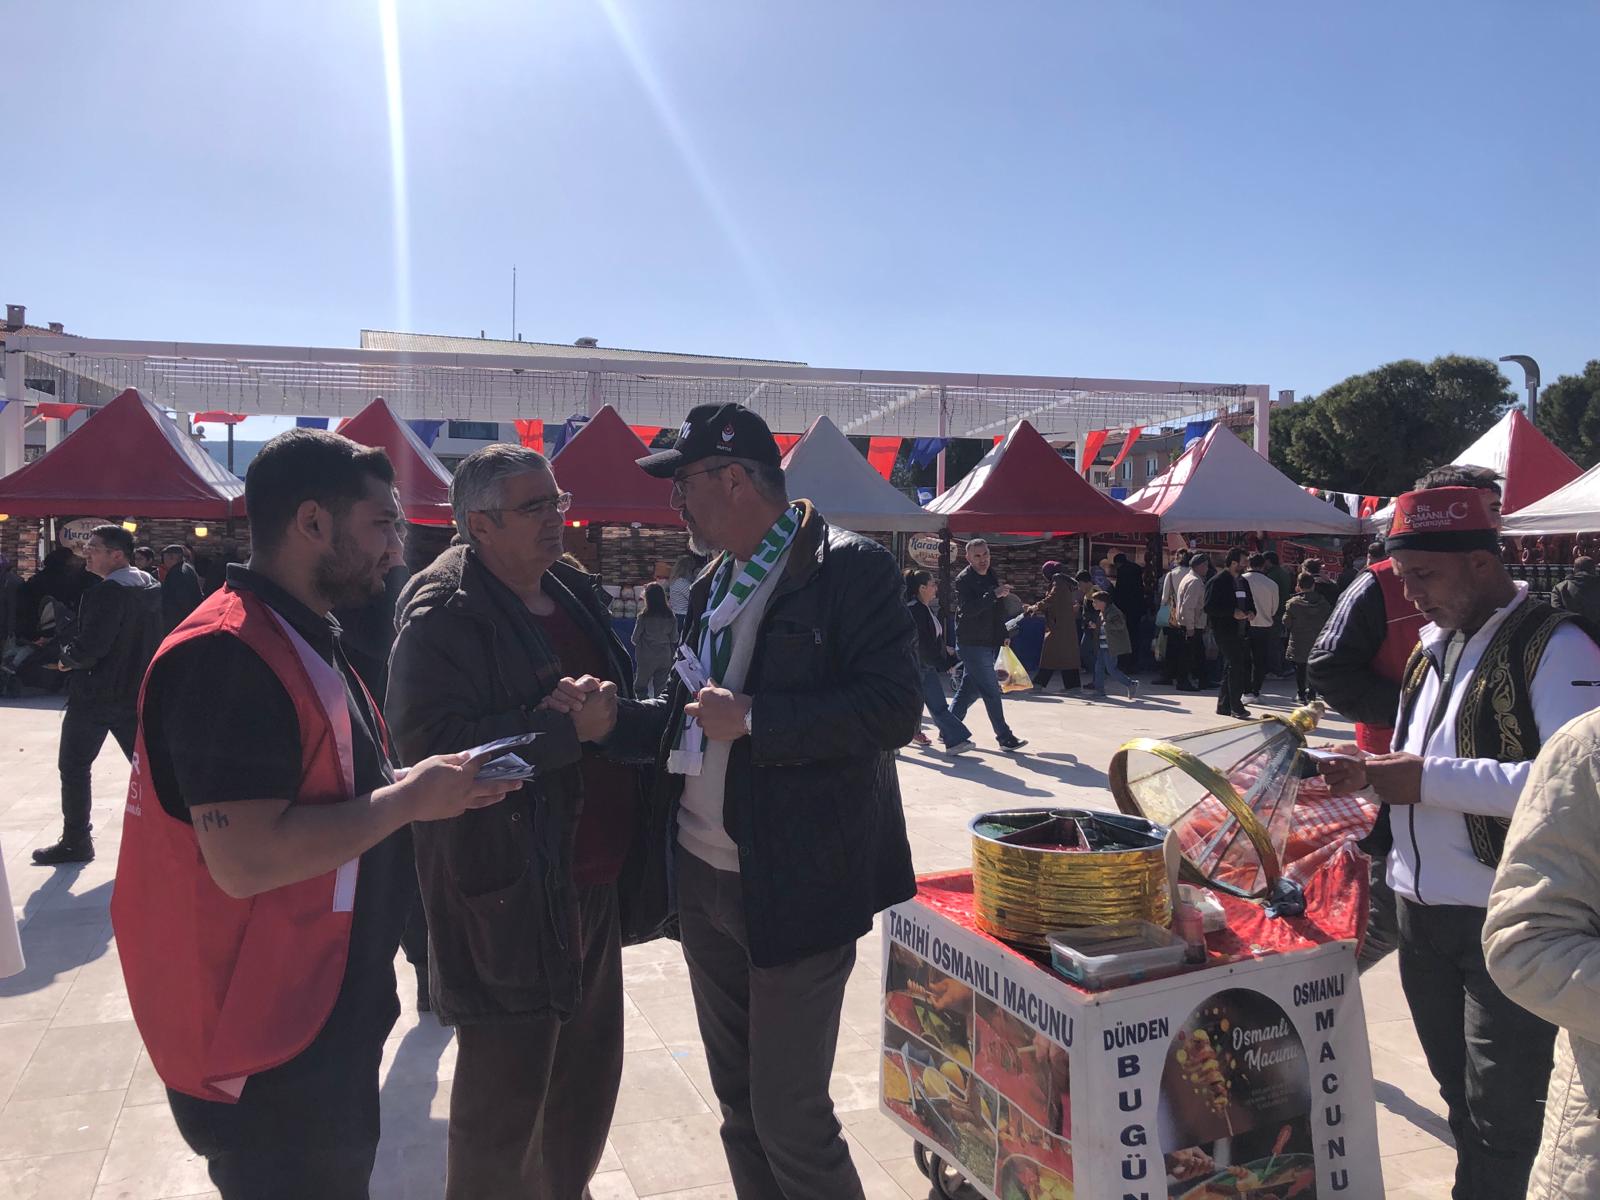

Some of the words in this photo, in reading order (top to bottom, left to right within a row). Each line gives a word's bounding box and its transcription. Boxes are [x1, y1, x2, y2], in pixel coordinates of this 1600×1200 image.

[890, 909, 929, 958] TARİHİ
[932, 938, 999, 1000] OSMANLI
[1003, 976, 1074, 1047] MACUNU
[1293, 973, 1345, 1007] OSMANLI
[1103, 1016, 1169, 1051] DÜNDEN
[1244, 1044, 1299, 1072] Macunu
[1315, 1008, 1349, 1191] MACUNU
